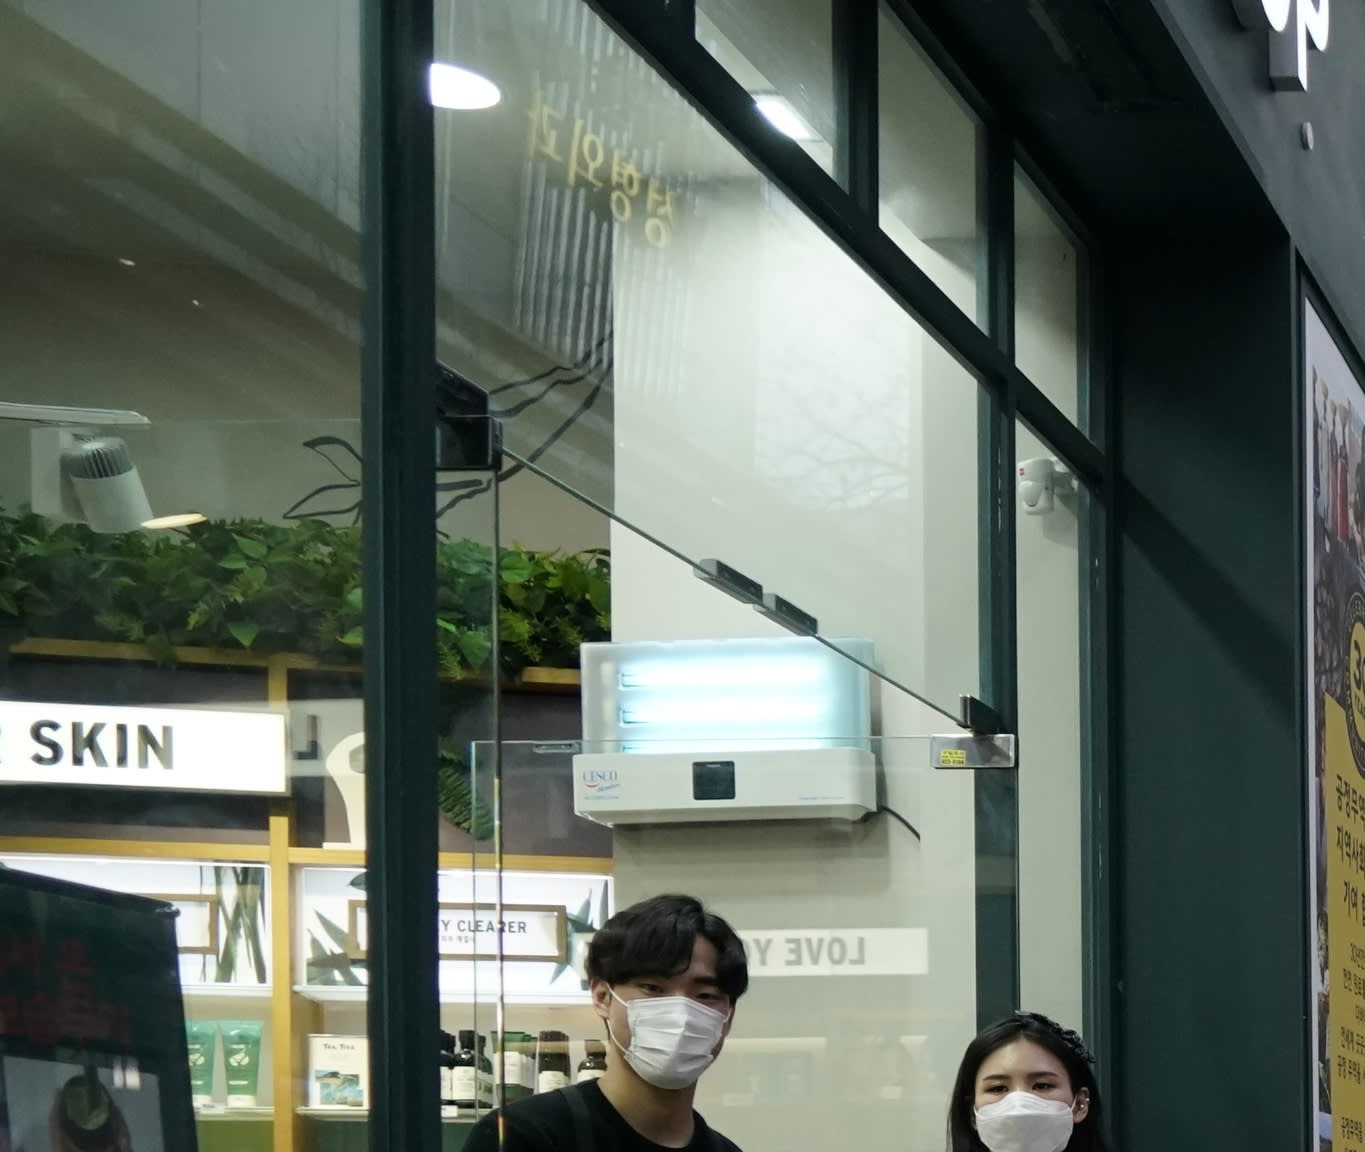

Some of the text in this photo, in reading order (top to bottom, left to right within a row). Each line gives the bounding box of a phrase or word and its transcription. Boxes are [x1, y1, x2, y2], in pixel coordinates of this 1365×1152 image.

[29, 719, 174, 770] SKIN
[1336, 825, 1365, 881] 지역사회
[1342, 880, 1359, 918] 기여
